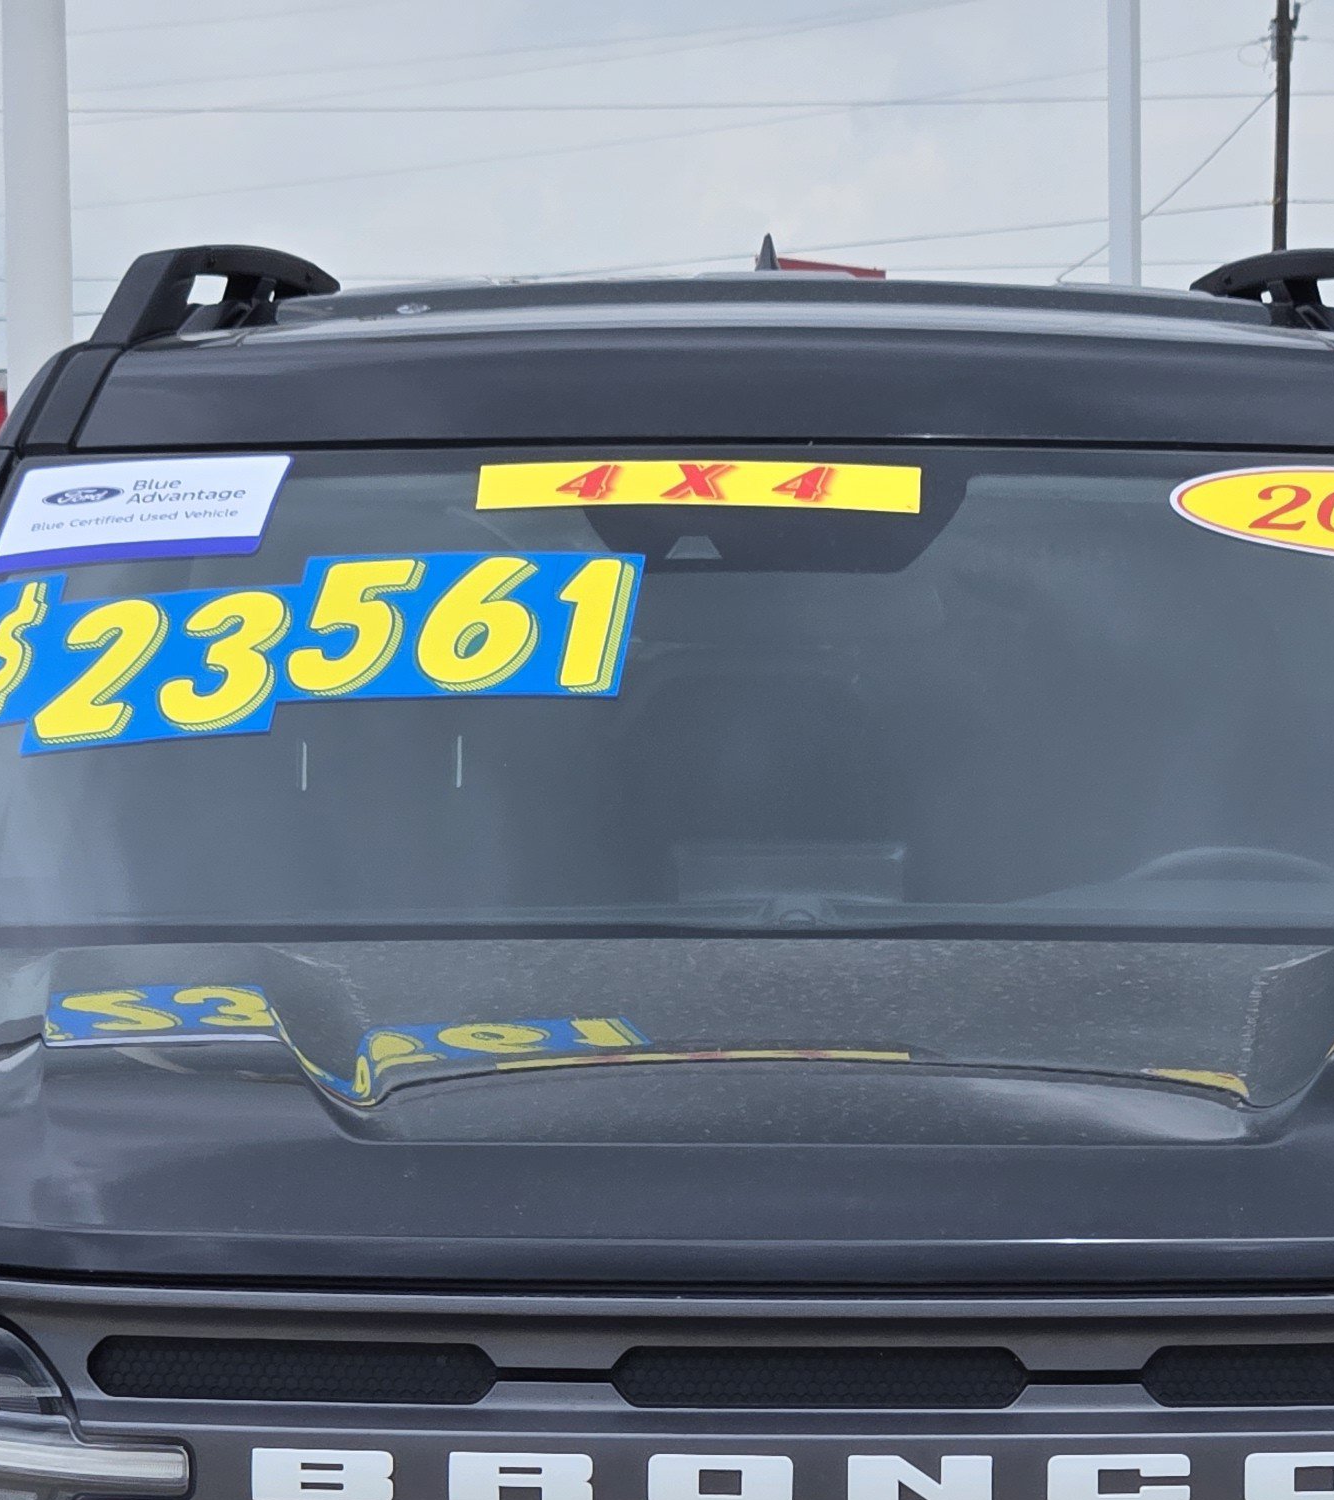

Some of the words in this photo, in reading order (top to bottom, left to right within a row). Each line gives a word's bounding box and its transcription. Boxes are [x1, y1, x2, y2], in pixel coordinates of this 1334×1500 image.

[132, 479, 182, 491] Blue
[56, 488, 110, 505] Ford
[126, 487, 247, 505] Advantage
[31, 521, 65, 532] Blue
[69, 513, 134, 528] Certified
[139, 510, 179, 522] Used
[184, 507, 239, 519] Vehicle
